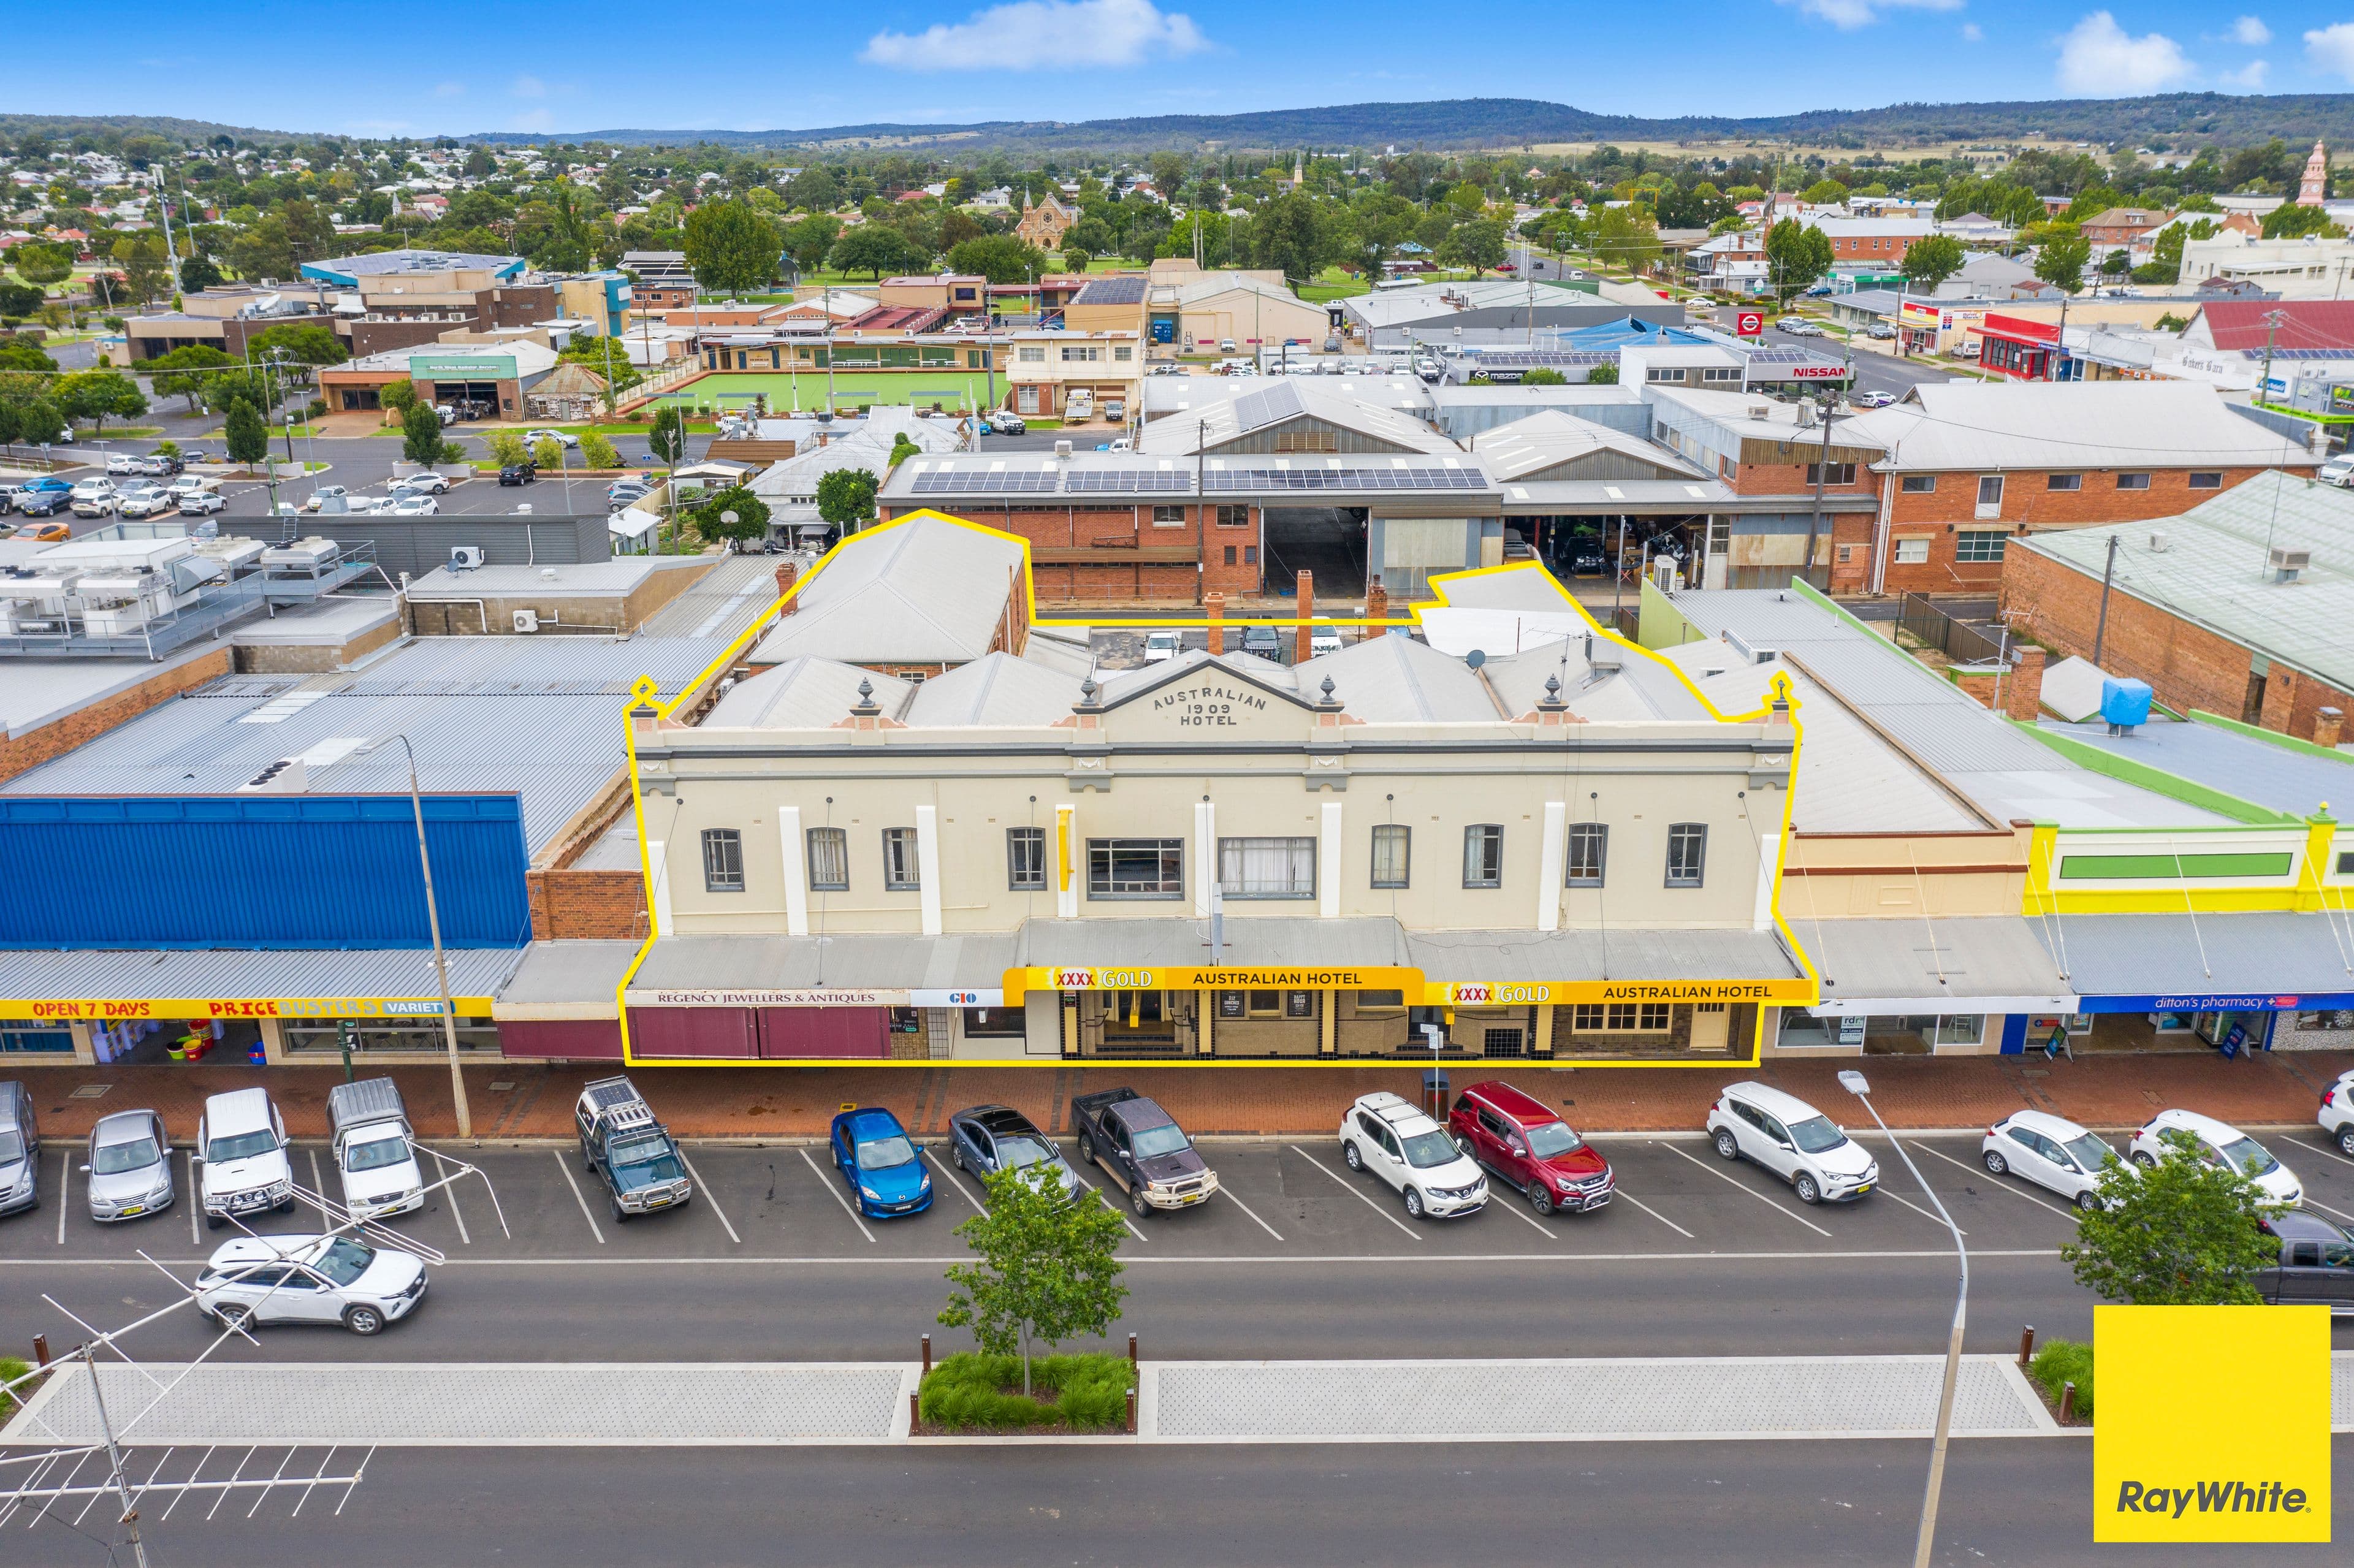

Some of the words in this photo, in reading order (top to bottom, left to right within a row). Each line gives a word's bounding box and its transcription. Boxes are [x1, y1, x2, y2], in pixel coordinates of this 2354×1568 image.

[1793, 367, 1849, 377] NISSAN
[1154, 687, 1267, 710] AUSTRALIAN
[1187, 704, 1230, 714] 1909
[1181, 716, 1237, 725] HOTEL
[1056, 972, 1095, 986] XXXX
[1102, 970, 1152, 988] GOLD
[1193, 973, 1301, 984] AUSTRALIAN
[1307, 973, 1362, 984] HOTEL
[1453, 988, 1492, 1001] XXXX
[1499, 986, 1550, 1002] GOLD
[1603, 987, 1712, 998] AUSTRALIAN
[1717, 986, 1772, 997] HOTEL
[723, 994, 791, 1003] JEWELLERS
[808, 994, 875, 1003] ANTIQUES
[950, 993, 977, 1003] GIO
[2155, 997, 2198, 1008] ditton's
[2201, 996, 2264, 1010] pharmacy
[33, 1002, 80, 1016] OPEN
[83, 1003, 96, 1016] 7
[105, 1002, 150, 1016] DAYS
